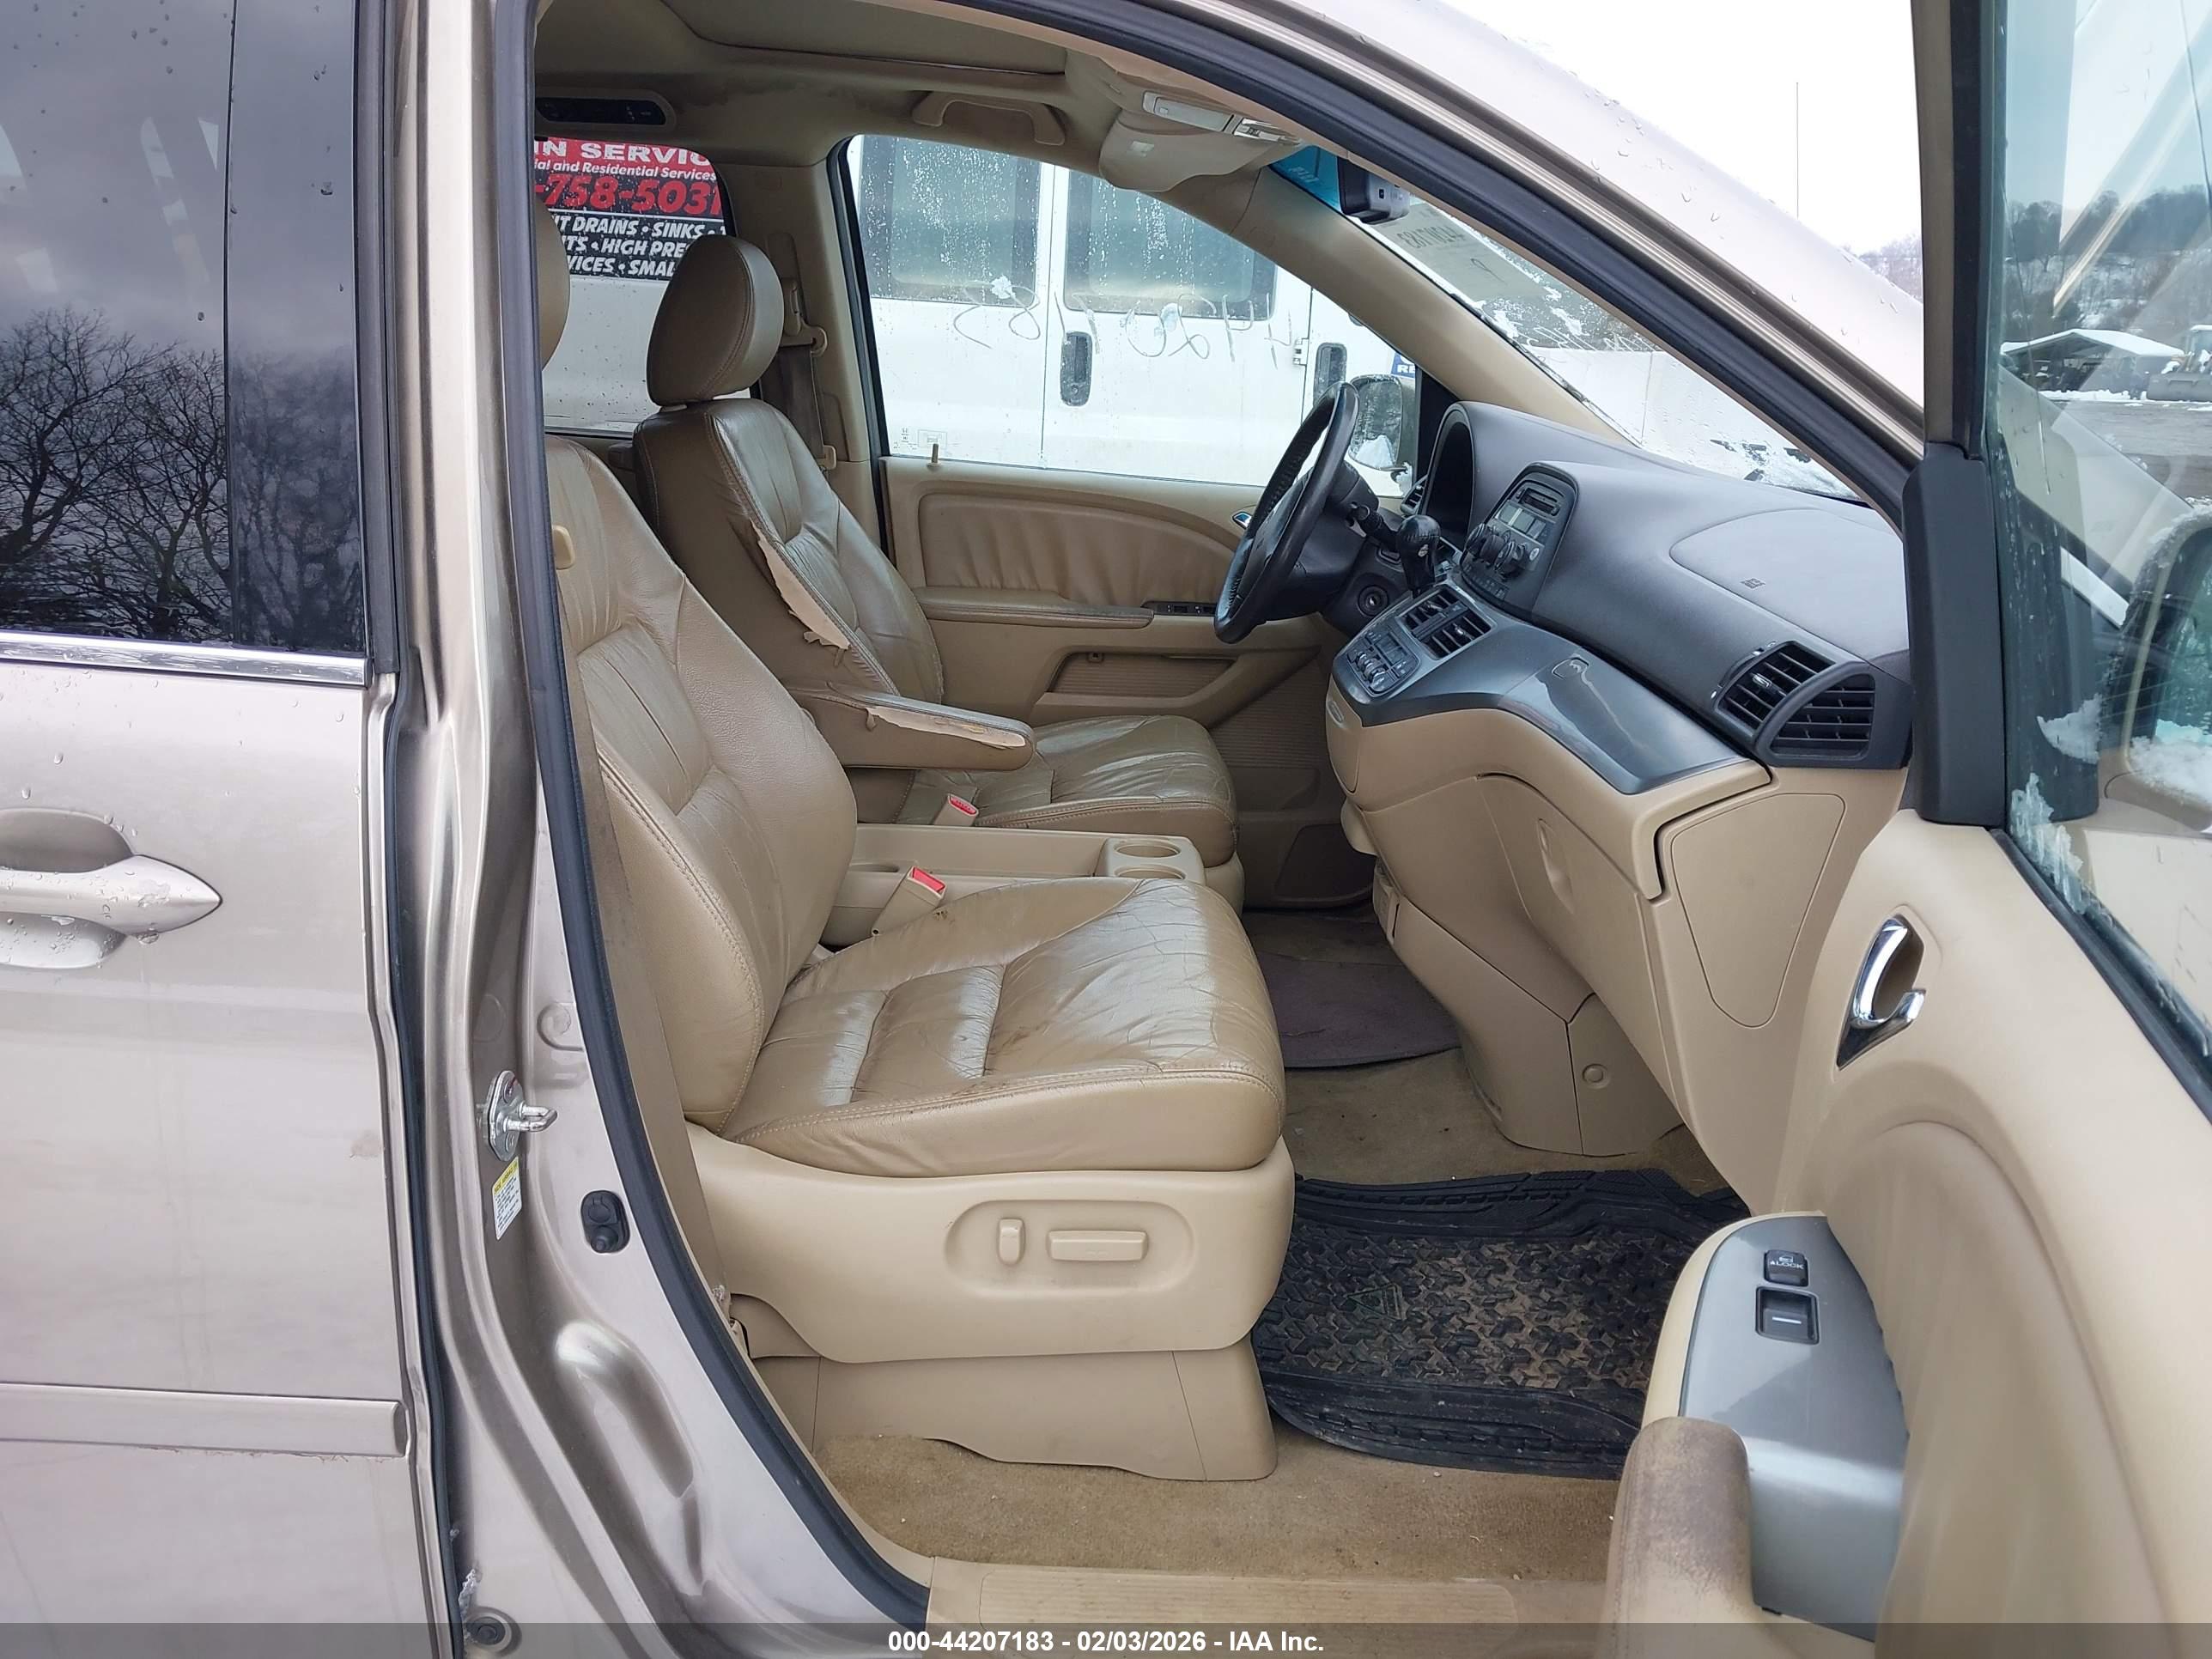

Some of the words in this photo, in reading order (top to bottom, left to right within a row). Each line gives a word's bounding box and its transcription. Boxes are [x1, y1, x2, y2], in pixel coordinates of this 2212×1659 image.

[553, 160, 580, 173] and
[582, 162, 658, 179] Residential
[660, 167, 717, 181] Services
[572, 216, 639, 235] DRAINS
[652, 221, 706, 240] SINKS
[600, 237, 647, 256] HIGH
[649, 240, 691, 259] PRE
[1776, 1260, 1804, 1270] LOCK
